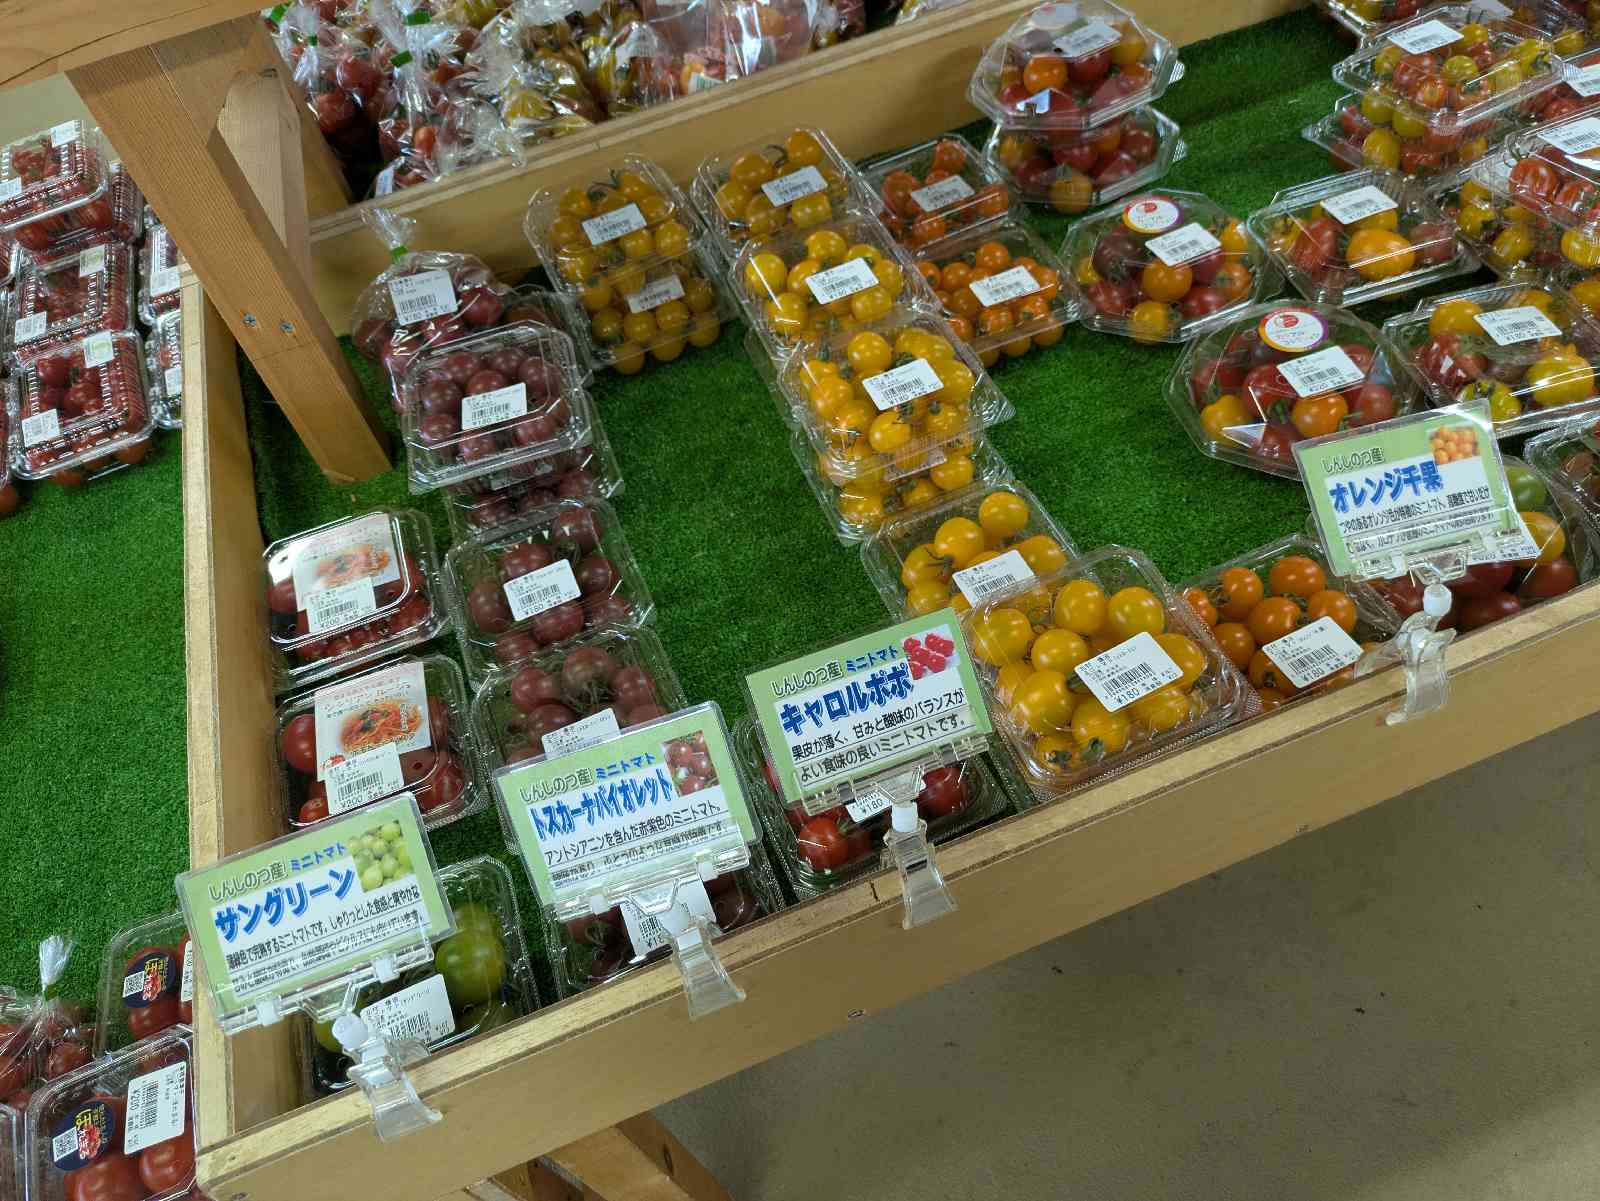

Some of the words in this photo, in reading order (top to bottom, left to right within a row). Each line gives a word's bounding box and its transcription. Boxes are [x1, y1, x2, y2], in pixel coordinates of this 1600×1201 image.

[1322, 447, 1385, 474] しんしのつ産
[1329, 460, 1444, 514] オレンジ千果
[319, 616, 341, 629] ¥200
[772, 661, 844, 697] しんしのつ産
[846, 645, 898, 673] ミニトマト
[1116, 687, 1140, 705] ¥180
[1303, 667, 1324, 682] ¥180
[780, 662, 914, 736] キャロルポポ
[791, 688, 965, 761] 果皮が薄く、甘みと酸味のバランスが
[800, 714, 965, 782] よい食味の良いミニトマトです。
[341, 795, 363, 808] ¥200
[519, 767, 595, 804] しんしのつ産
[595, 751, 656, 780] ミニトマト
[530, 768, 673, 840] トスカーナバイオレット
[544, 799, 721, 865] アントシアニンを含んだ赤紫色のミニトマト。
[860, 797, 883, 815] ¥180
[208, 862, 288, 902] しんしのつ産
[290, 841, 347, 872] ミニトマト
[215, 868, 355, 943] サングリーン
